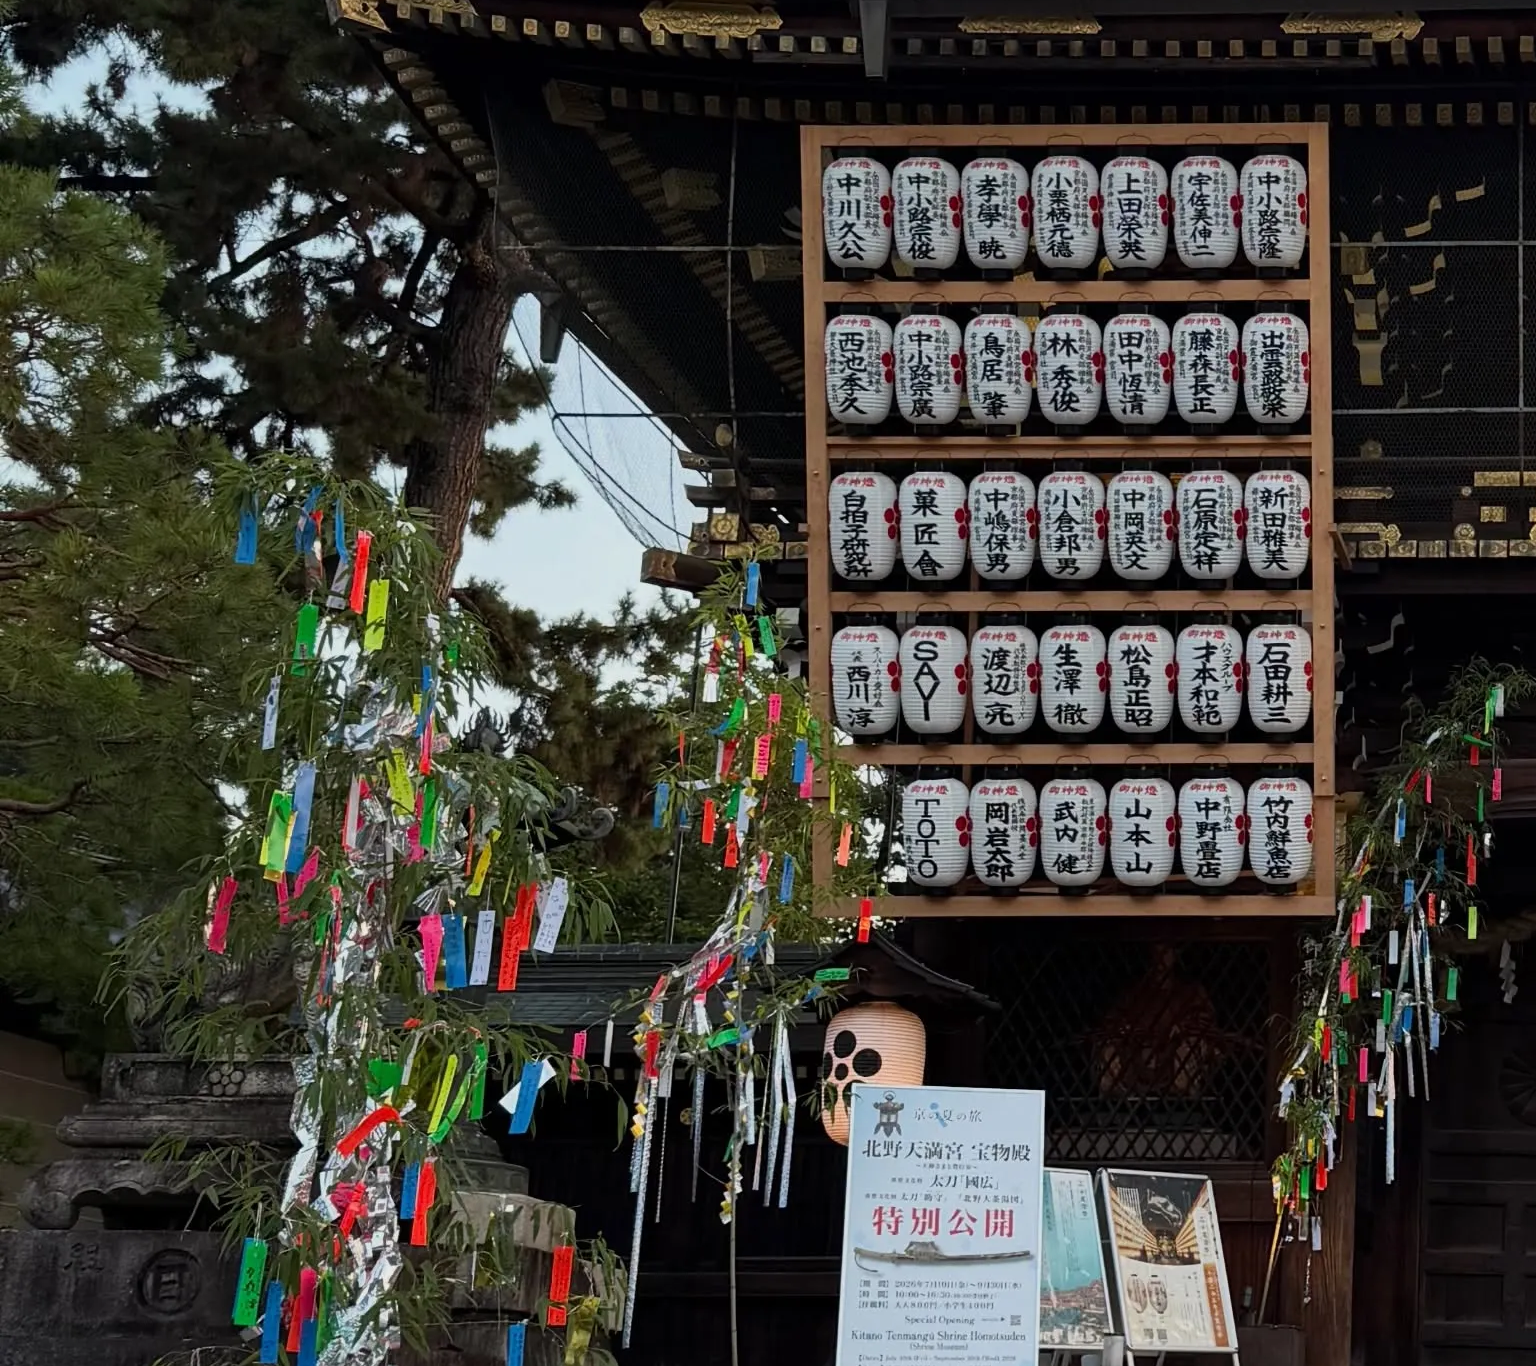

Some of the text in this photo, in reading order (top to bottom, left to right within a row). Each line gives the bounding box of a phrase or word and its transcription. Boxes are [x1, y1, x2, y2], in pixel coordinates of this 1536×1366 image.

[837, 174, 865, 261] 中川久公
[907, 173, 936, 259] 中小路宗俊
[1187, 173, 1215, 256] 宇佐美伸二
[1257, 172, 1284, 259] 中小路宗隆
[839, 332, 869, 414] 西池季久
[1047, 333, 1081, 412] 林秀俊
[1188, 330, 1217, 414] 藤森長正
[839, 490, 873, 578] 白拍子研究所
[912, 489, 944, 577] 菓匠會
[1052, 490, 1082, 576] 小倉邦男
[1123, 489, 1150, 571] 中岡英文
[1191, 488, 1221, 574] 石原定祥
[1259, 487, 1289, 571] 新田雅美
[846, 666, 875, 728] 西川淳
[981, 647, 1015, 726] 渡辺亮
[1052, 643, 1088, 726] 生澤徹
[1120, 644, 1153, 727] 松島正昭
[1189, 641, 1222, 726] 才本和範
[1257, 643, 1293, 724] 石田耕三
[915, 799, 940, 878] TOTO
[984, 802, 1014, 882] 岡岩太郎
[1052, 801, 1083, 875] 武内健
[1123, 799, 1153, 874] 山本山
[1261, 797, 1294, 879] 竹内鮮魚店
[862, 1139, 1031, 1161] 北野天満宮 宝物殿
[913, 1108, 982, 1122] 京の夏の旅
[871, 1206, 1014, 1238] 特別公開
[851, 1331, 882, 1340] Kitano
[938, 1331, 968, 1340] Shrine
[905, 1316, 975, 1325] Special Opening
